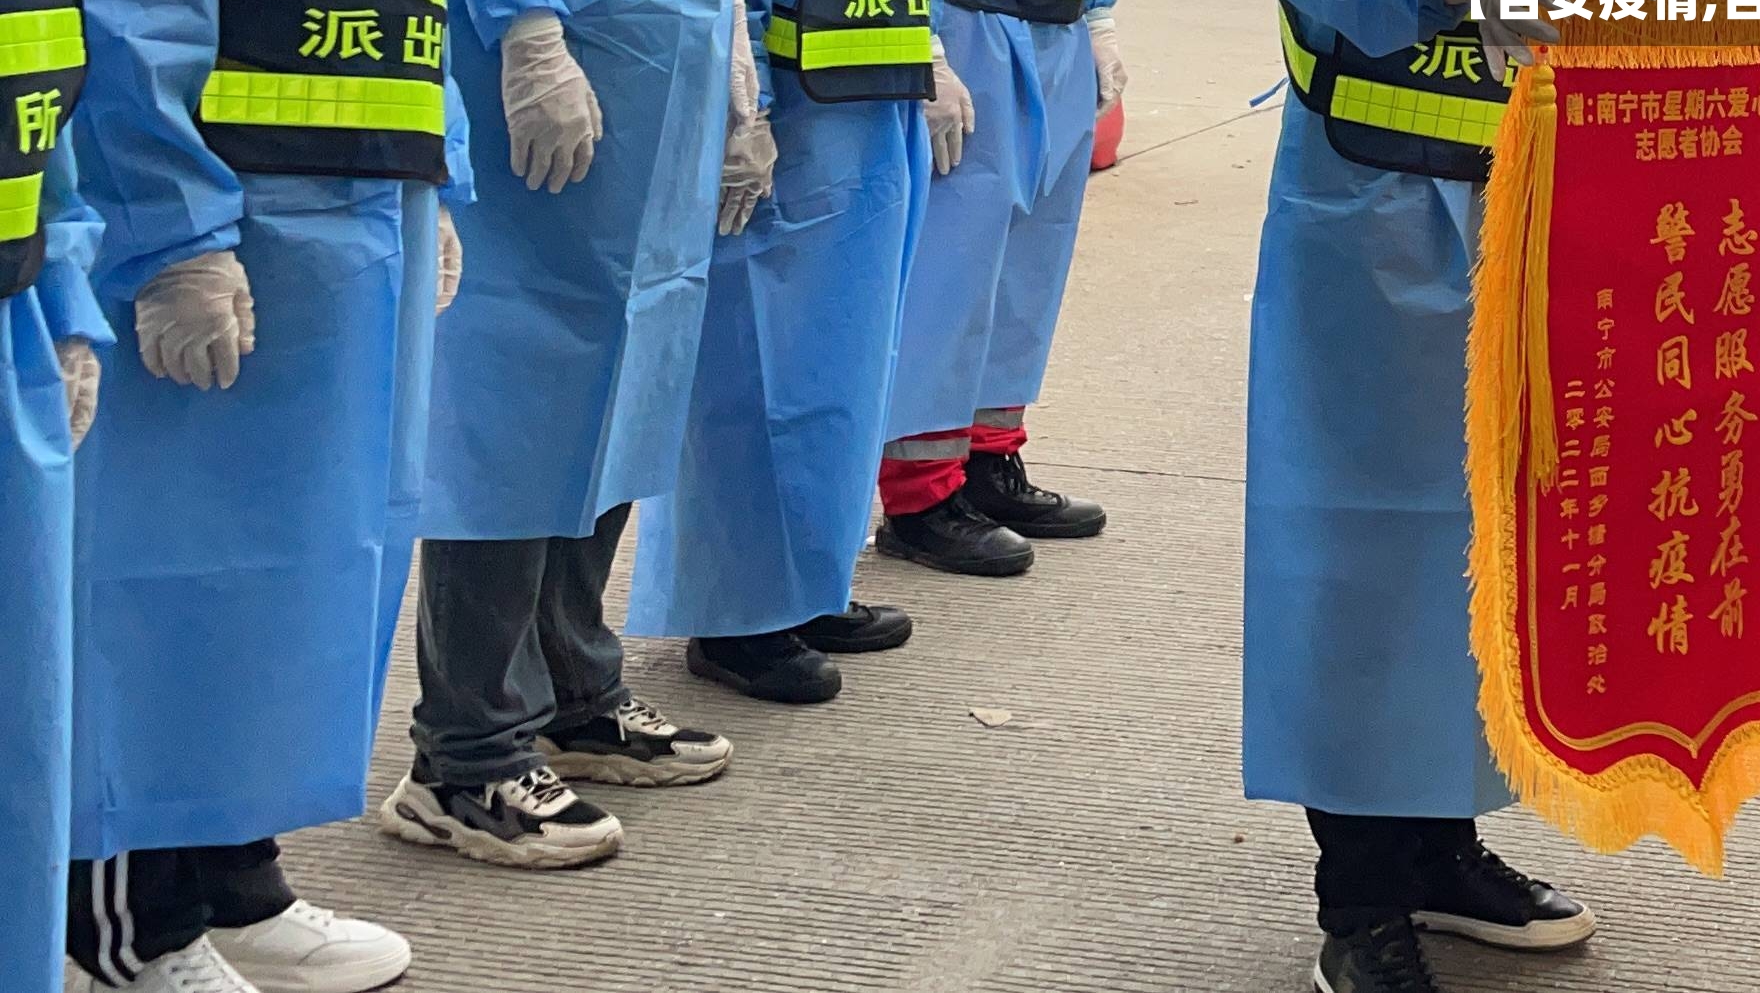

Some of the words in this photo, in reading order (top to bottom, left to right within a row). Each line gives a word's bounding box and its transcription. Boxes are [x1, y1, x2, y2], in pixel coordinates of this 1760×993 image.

[299, 7, 442, 69] 派出
[15, 88, 62, 154] 所
[1636, 125, 1743, 160] 志愿者协会
[1647, 202, 1699, 655] 警民同心抗疫情
[1709, 198, 1758, 639] 志愿服务勇在前
[1559, 380, 1585, 610] 二零二二年十一月
